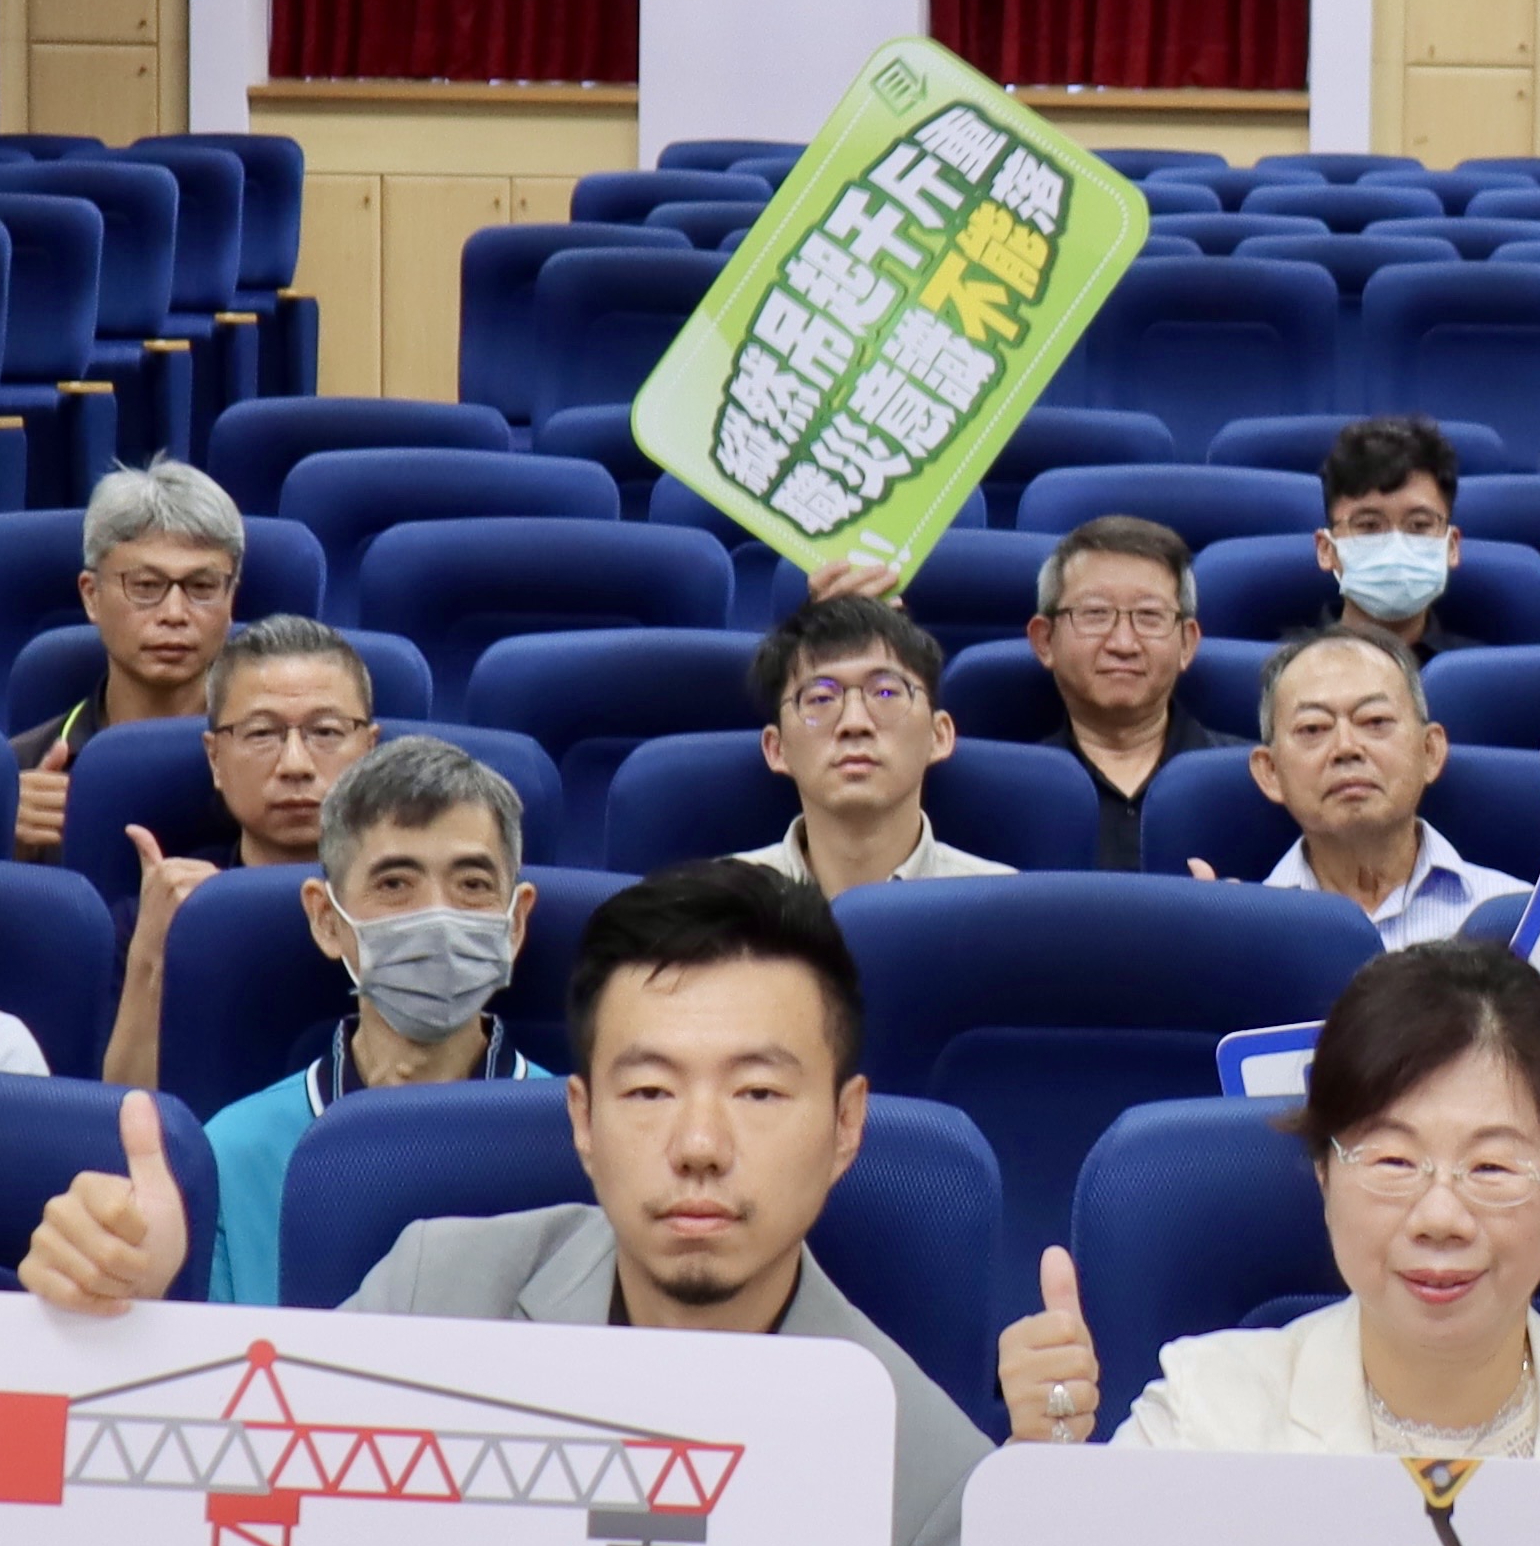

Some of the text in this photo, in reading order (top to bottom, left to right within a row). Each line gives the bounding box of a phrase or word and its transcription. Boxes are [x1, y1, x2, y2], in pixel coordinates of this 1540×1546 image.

[716, 105, 1009, 496] 縱然吊起千斤重
[770, 146, 1065, 536] 職災意識不能落
